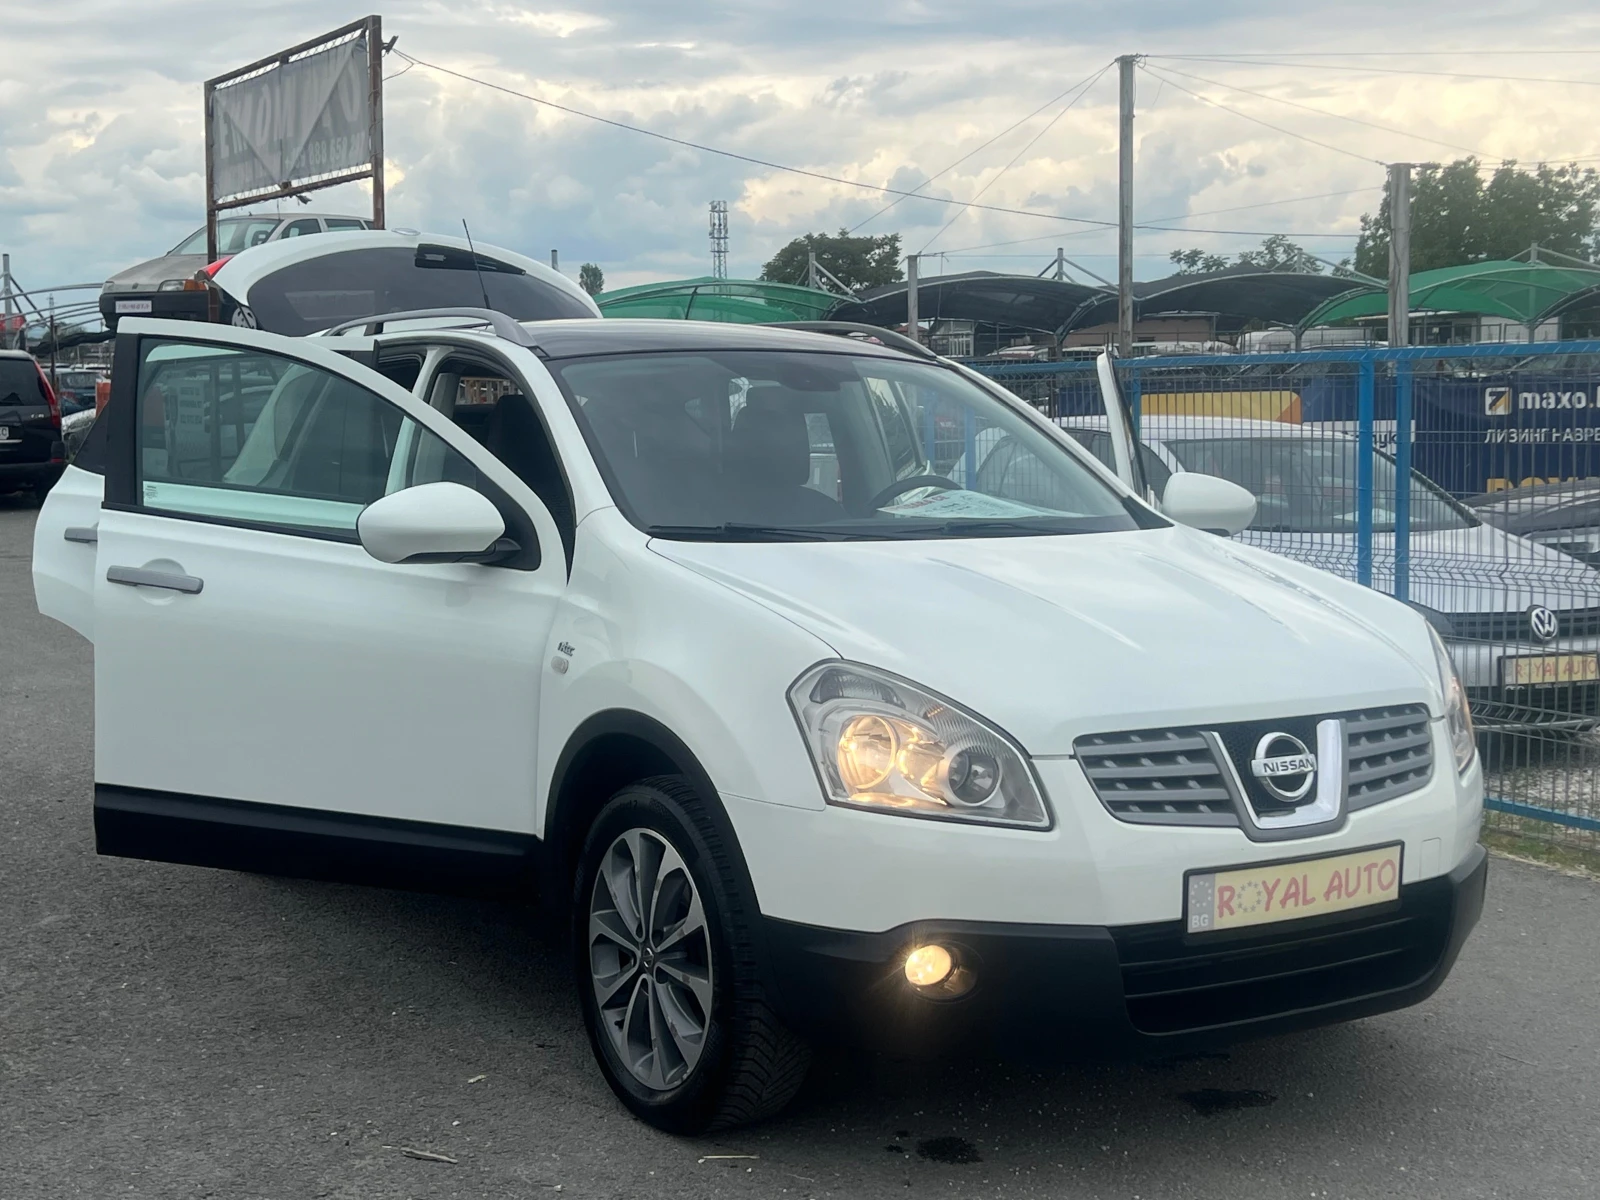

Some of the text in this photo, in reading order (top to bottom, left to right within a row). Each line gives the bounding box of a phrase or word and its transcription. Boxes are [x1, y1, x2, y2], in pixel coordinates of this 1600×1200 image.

[1484, 428, 1550, 444] ЛИЗИНГ
[1263, 757, 1315, 774] NISSAN
[1323, 859, 1397, 902] AUTO
[1191, 914, 1209, 928] BG
